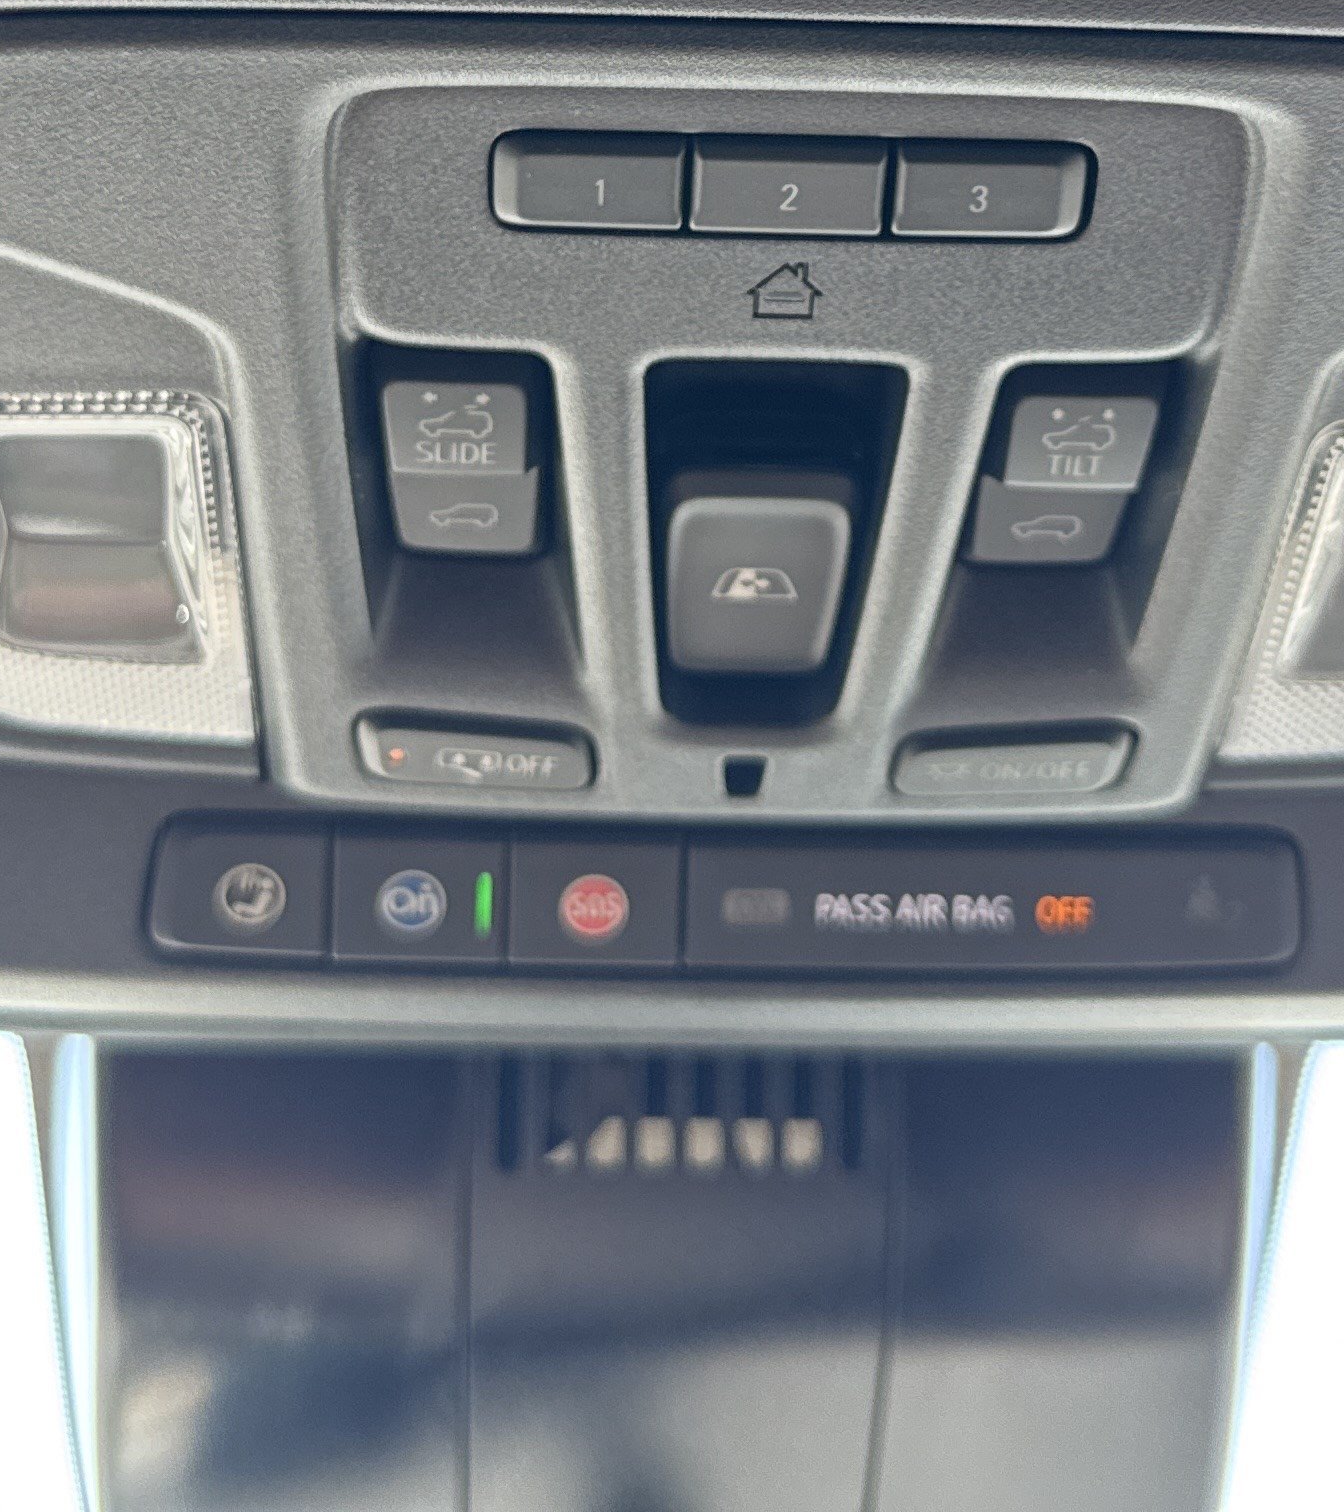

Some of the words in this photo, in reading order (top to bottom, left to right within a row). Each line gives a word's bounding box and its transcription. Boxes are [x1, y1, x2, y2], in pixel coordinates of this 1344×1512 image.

[594, 178, 606, 206] 1
[778, 183, 801, 212] 2
[967, 184, 990, 213] 3
[415, 440, 498, 465] SLIDE
[1048, 453, 1104, 477] TILT
[505, 753, 557, 776] OFF
[564, 891, 624, 918] SOS
[814, 892, 893, 924] PASS
[895, 892, 949, 925] AIR
[951, 893, 1015, 926] BAG
[1035, 894, 1094, 929] OFF
